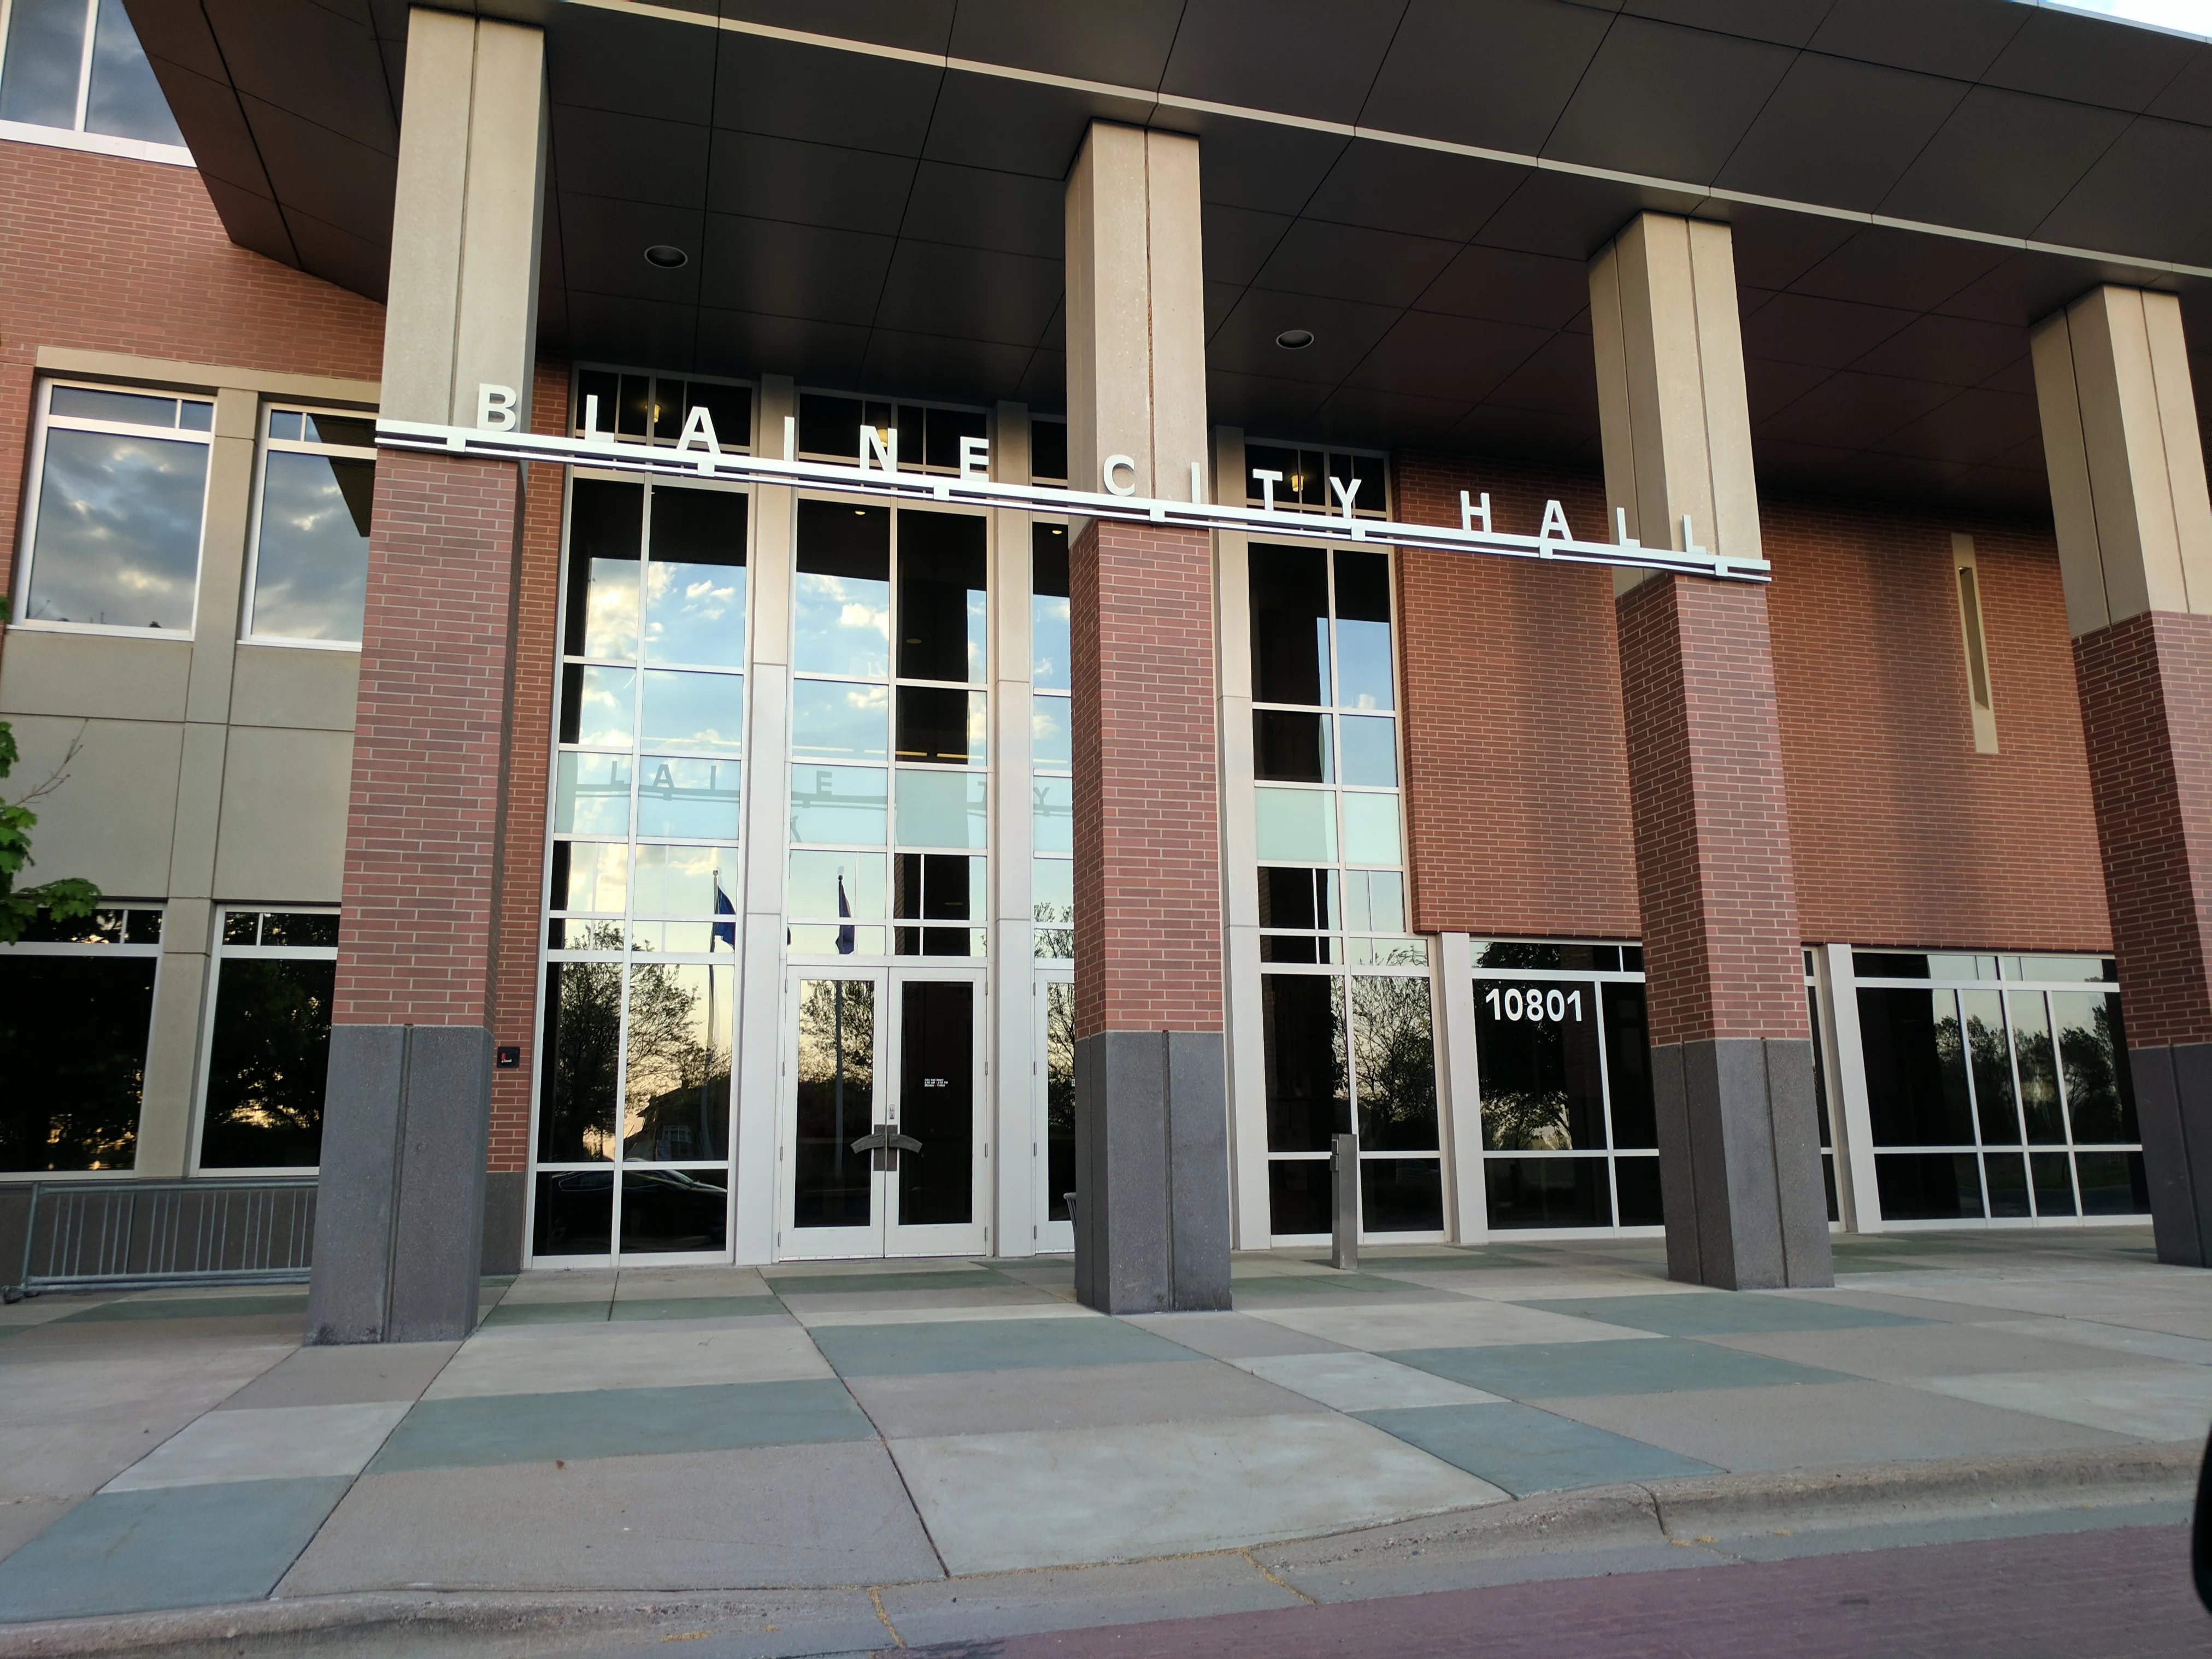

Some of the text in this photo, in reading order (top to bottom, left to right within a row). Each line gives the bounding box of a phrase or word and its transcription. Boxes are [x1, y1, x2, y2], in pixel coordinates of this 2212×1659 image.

[477, 383, 1707, 554] BLAINE CITY HALL
[1486, 989, 1582, 1021] 10801
